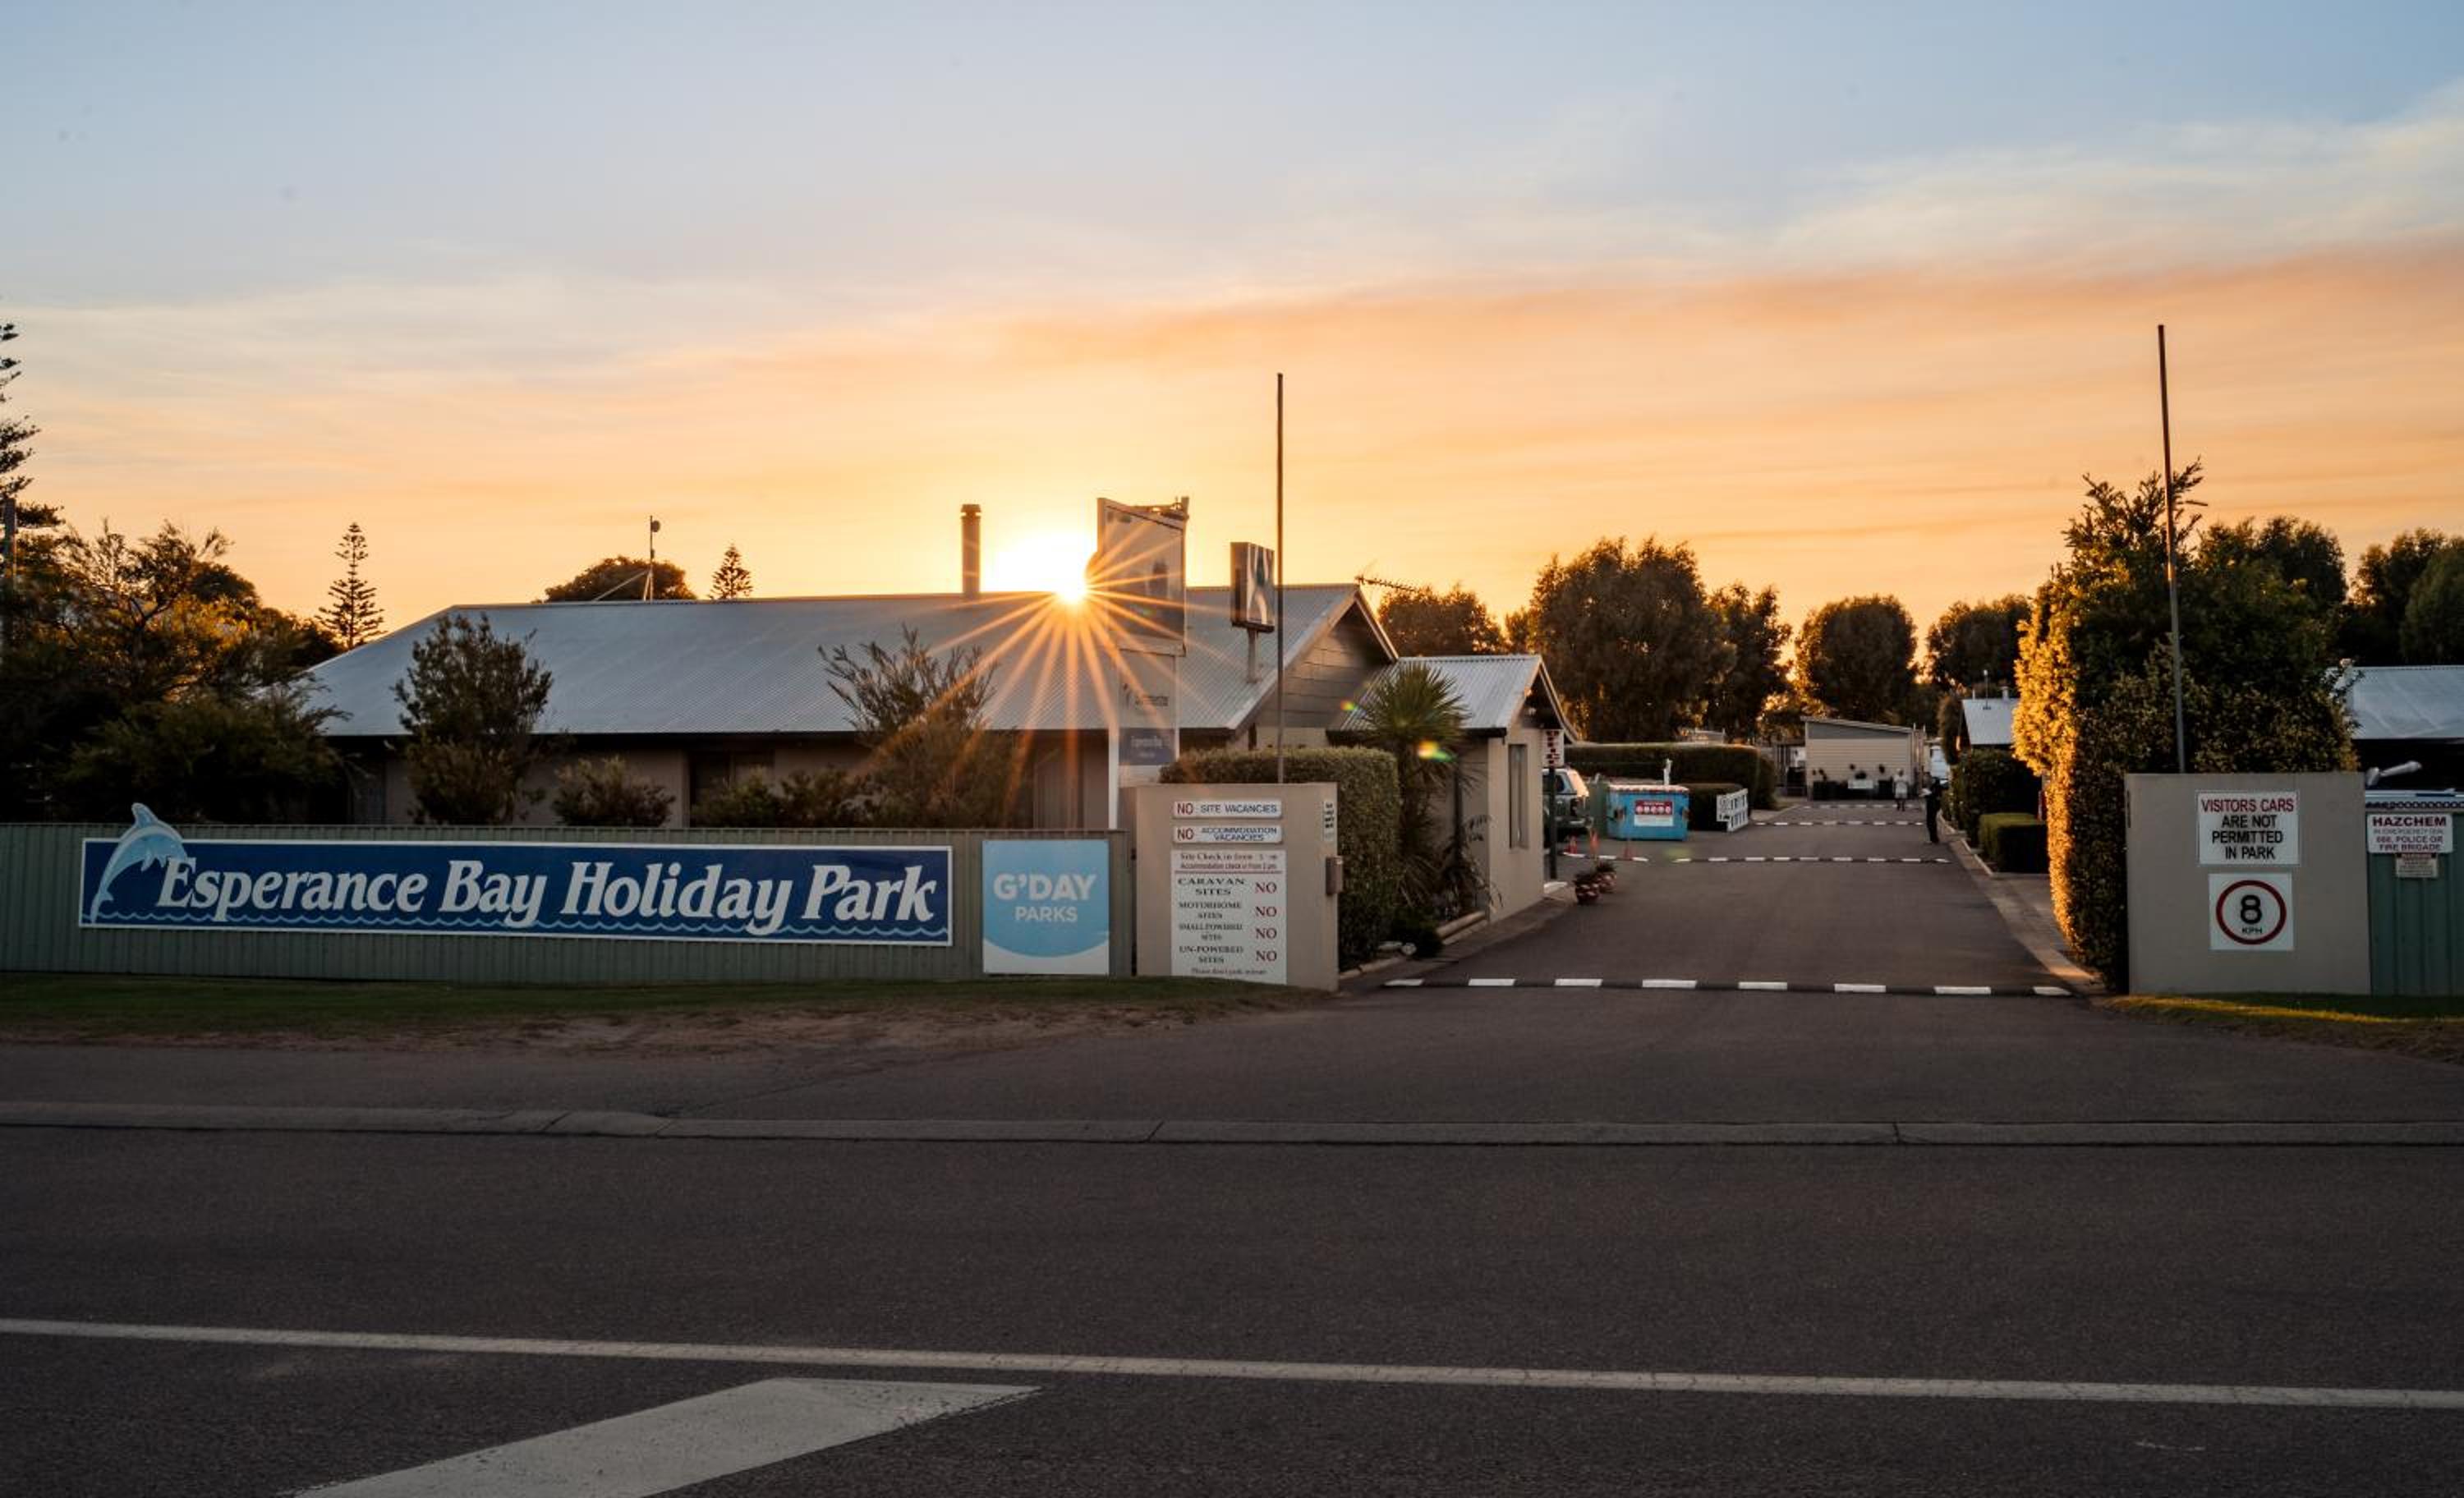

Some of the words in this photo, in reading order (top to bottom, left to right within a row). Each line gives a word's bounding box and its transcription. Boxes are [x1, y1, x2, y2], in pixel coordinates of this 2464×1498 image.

[1177, 803, 1193, 815] NO
[1200, 804, 1221, 813] SITE
[1225, 804, 1277, 813] VACANCIES
[2200, 799, 2256, 812] VISITORS
[2260, 798, 2294, 811] CARS
[2221, 816, 2249, 828] ARE
[2253, 816, 2277, 827] NOT
[2373, 816, 2446, 826] HAZCHEM
[1177, 829, 1194, 839] NO
[2212, 831, 2283, 843] PERMITTED
[2225, 846, 2237, 859] IN
[2241, 847, 2275, 859] PARK
[993, 874, 1096, 901] G'DAY
[1255, 882, 1277, 894] NO
[156, 857, 428, 921] Esperance
[439, 860, 548, 929] Bay
[563, 862, 792, 935] Holiday
[802, 864, 937, 922] Park
[1015, 907, 1078, 923] PARKS
[1255, 906, 1277, 917] NO
[2240, 894, 2263, 925] 8
[1255, 928, 1277, 940] NO
[2242, 926, 2263, 935] KPH
[1255, 951, 1277, 962] NO
